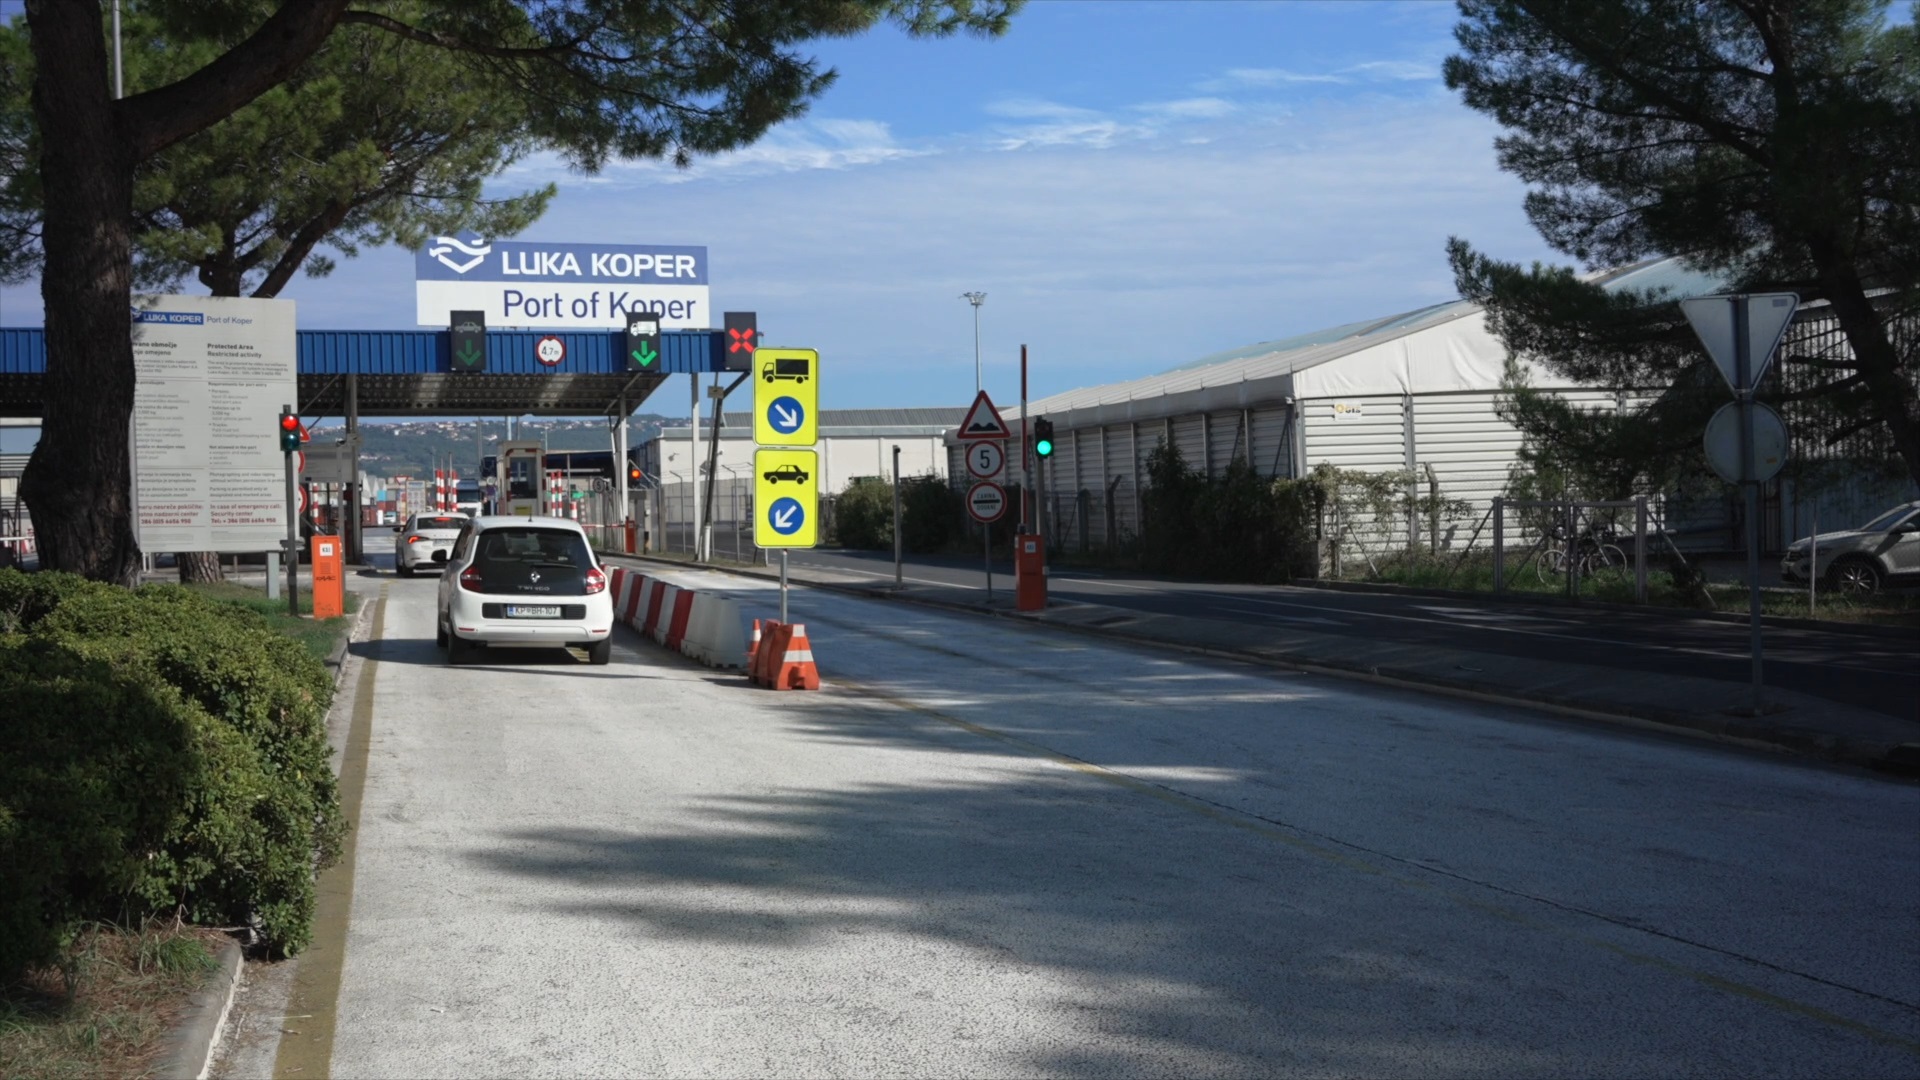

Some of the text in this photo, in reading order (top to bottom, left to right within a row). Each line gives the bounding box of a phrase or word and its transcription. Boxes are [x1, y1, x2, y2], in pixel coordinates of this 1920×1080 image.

[502, 251, 696, 278] LUKA KOPER
[504, 290, 696, 319] Port of Koper
[144, 314, 202, 323] LUKA KOPER
[232, 317, 253, 325] Koper
[980, 450, 990, 469] 5
